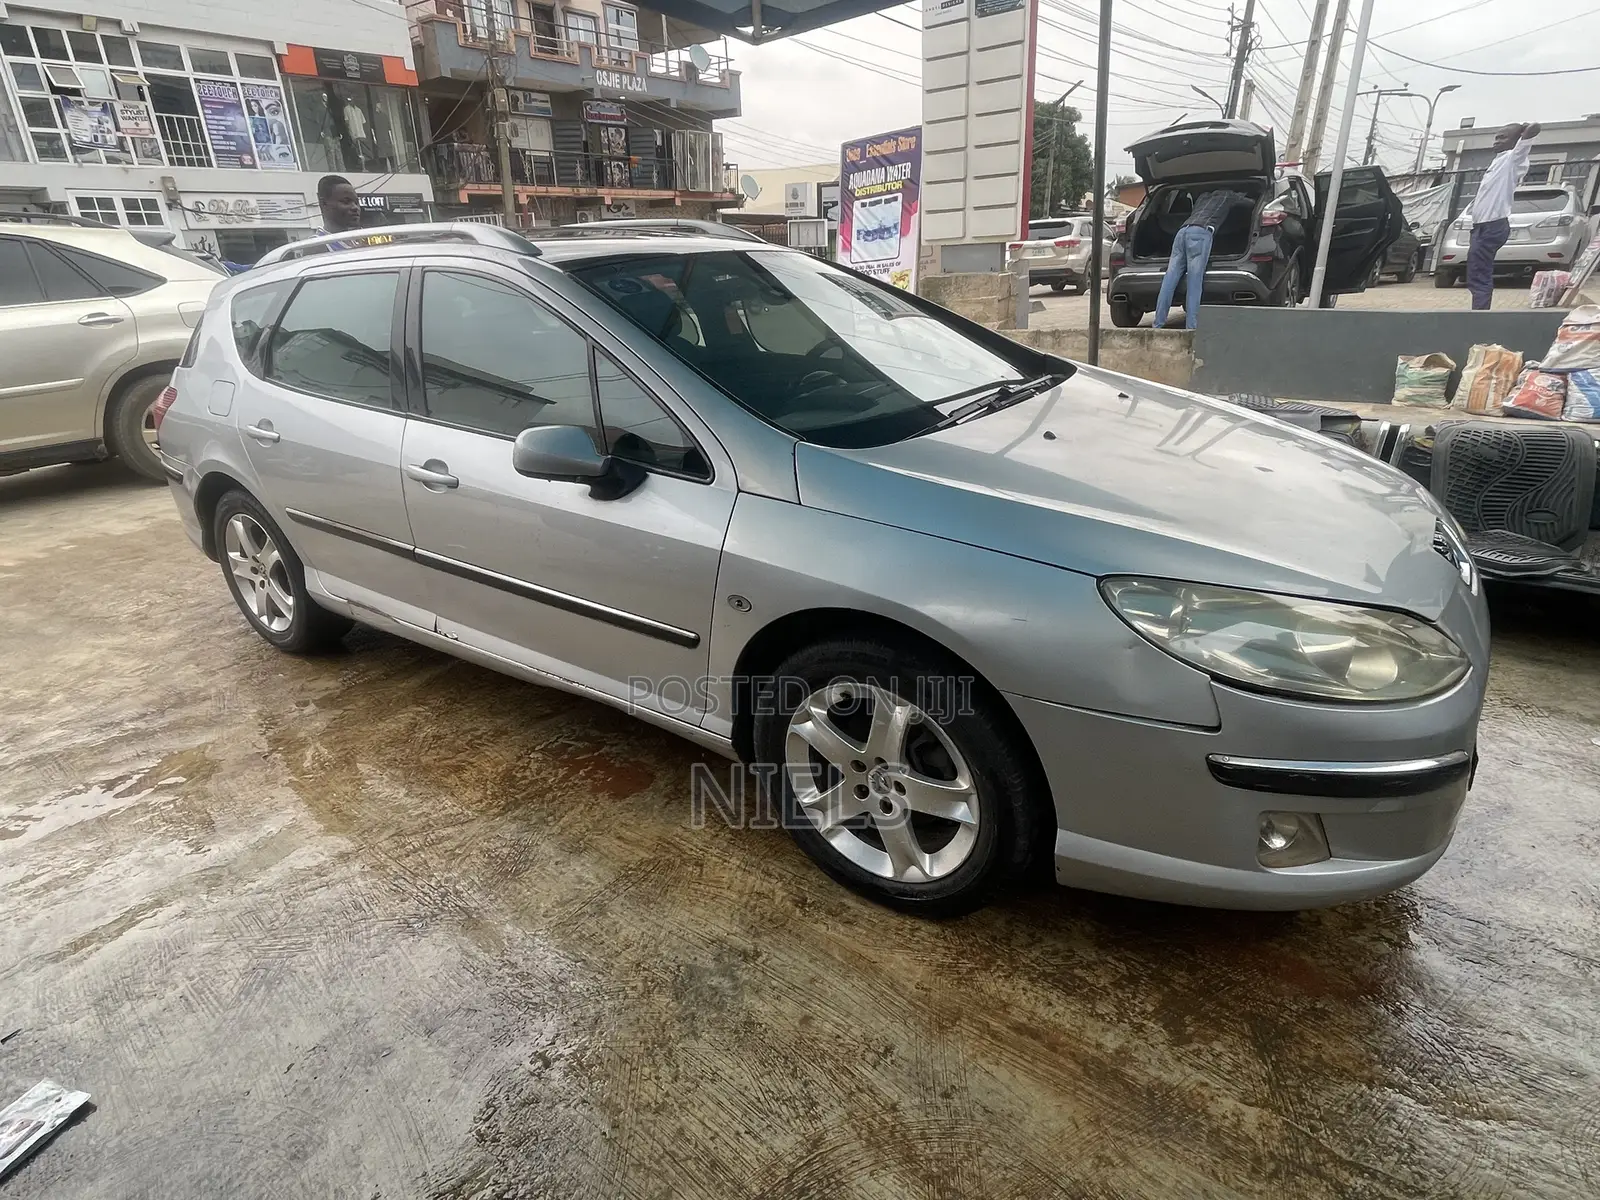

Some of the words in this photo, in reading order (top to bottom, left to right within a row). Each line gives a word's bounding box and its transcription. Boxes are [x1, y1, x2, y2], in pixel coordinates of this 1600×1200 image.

[596, 70, 620, 88] OSJIE
[622, 74, 648, 93] PLAZA
[121, 109, 145, 117] STYLIST
[898, 135, 917, 152] Store
[886, 162, 912, 183] WATER
[855, 180, 904, 197] DISTRIBUTOR
